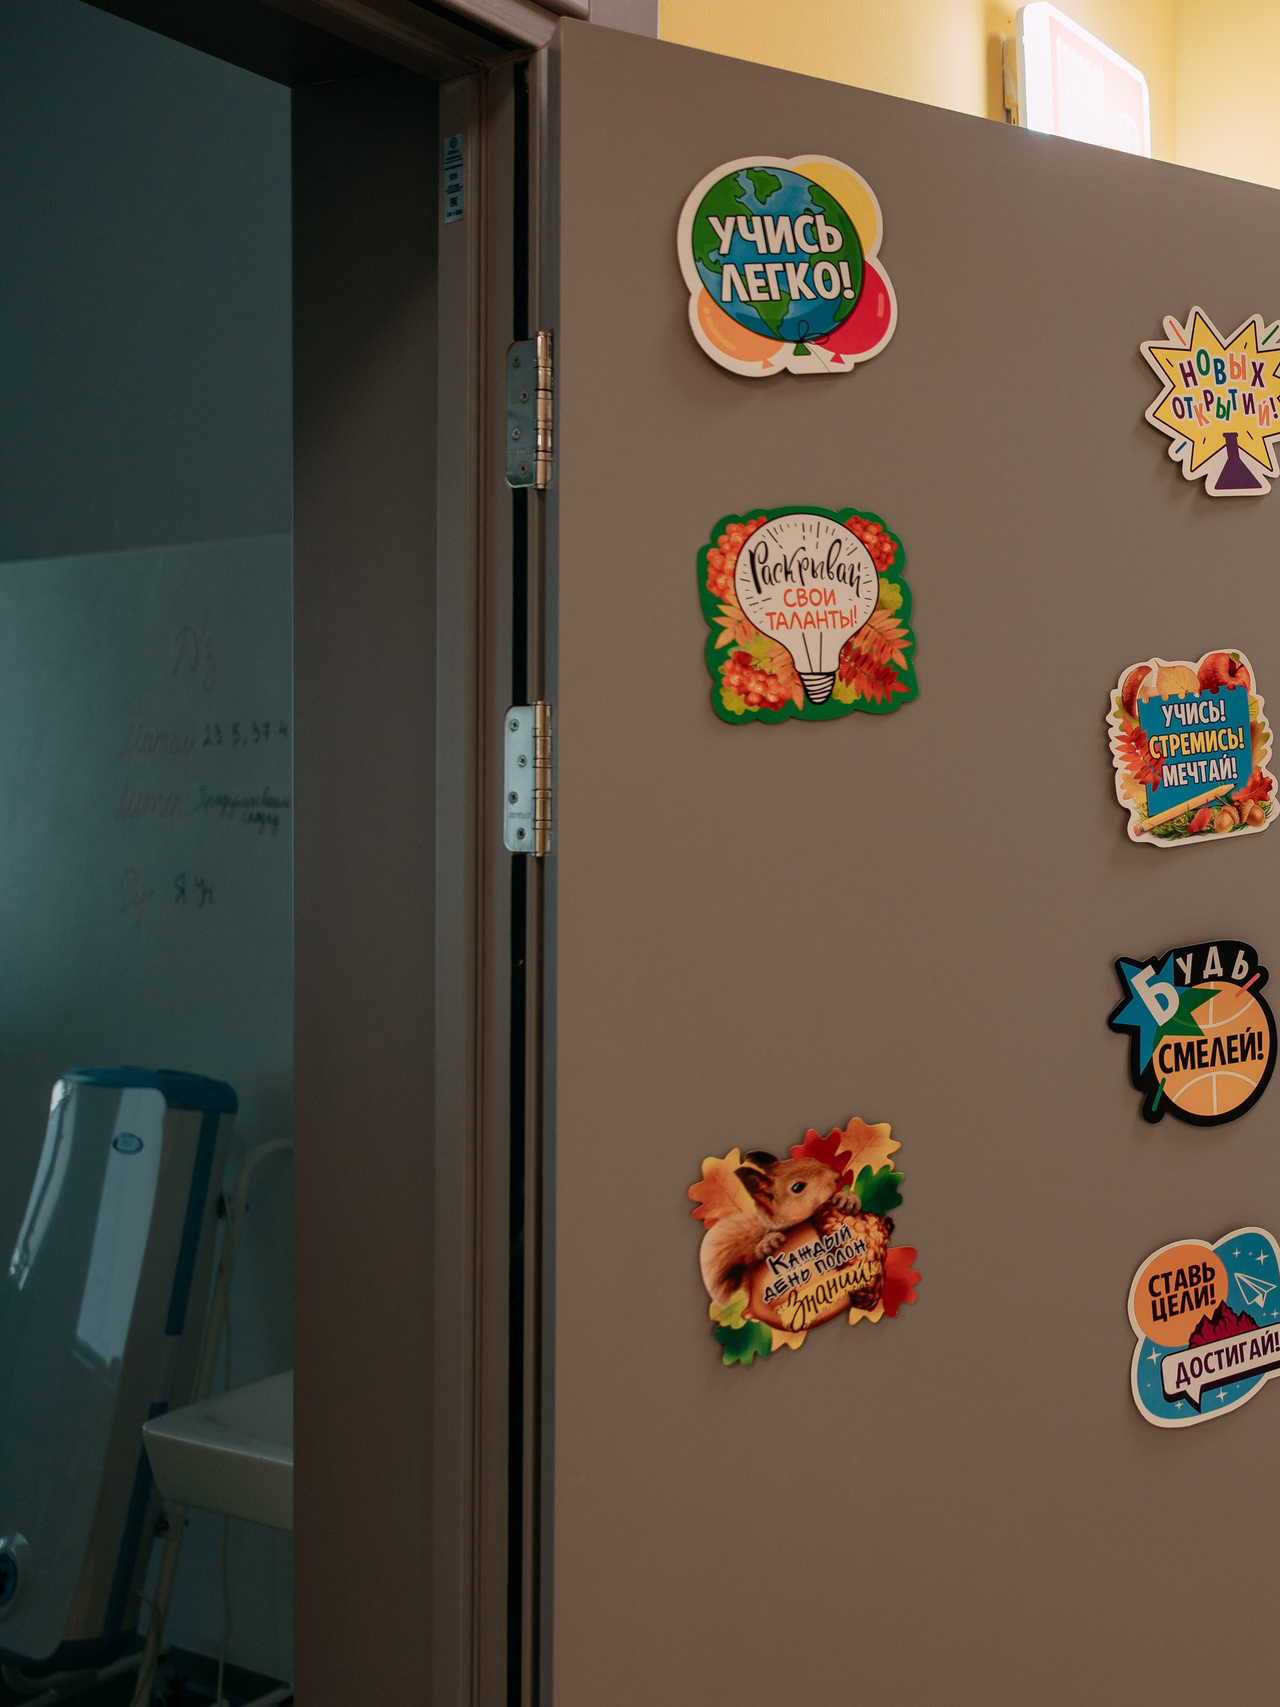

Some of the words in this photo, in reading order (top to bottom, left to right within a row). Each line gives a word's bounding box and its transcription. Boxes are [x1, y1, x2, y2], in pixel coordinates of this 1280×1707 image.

[707, 213, 843, 255] УЧИСЬ
[721, 260, 856, 302] ЛЕГКО!
[1178, 349, 1265, 388] НОВЫХ
[1171, 388, 1279, 427] ОТКРЫТИЙ!
[748, 538, 862, 598] Раскрывай
[765, 604, 858, 631] ТАЛАНТЫ!
[783, 587, 837, 608] СВОИ
[1160, 699, 1227, 728] УЧИСЬ!
[1149, 727, 1246, 759] СТРЕМИСЬ!
[1161, 753, 1239, 788] МЕЧТАЙ!
[1130, 945, 1250, 1027] БУДЬ
[1158, 1026, 1265, 1075] СМЕЛЕЙ!
[763, 1268, 810, 1302] ДЕНЬ
[813, 1238, 866, 1274] ПОЛОН
[1148, 1261, 1216, 1298] СТАВЬ
[1150, 1282, 1217, 1323] ЦЕЛИ!
[1175, 1329, 1280, 1390] ДОСТИГАЙ!
